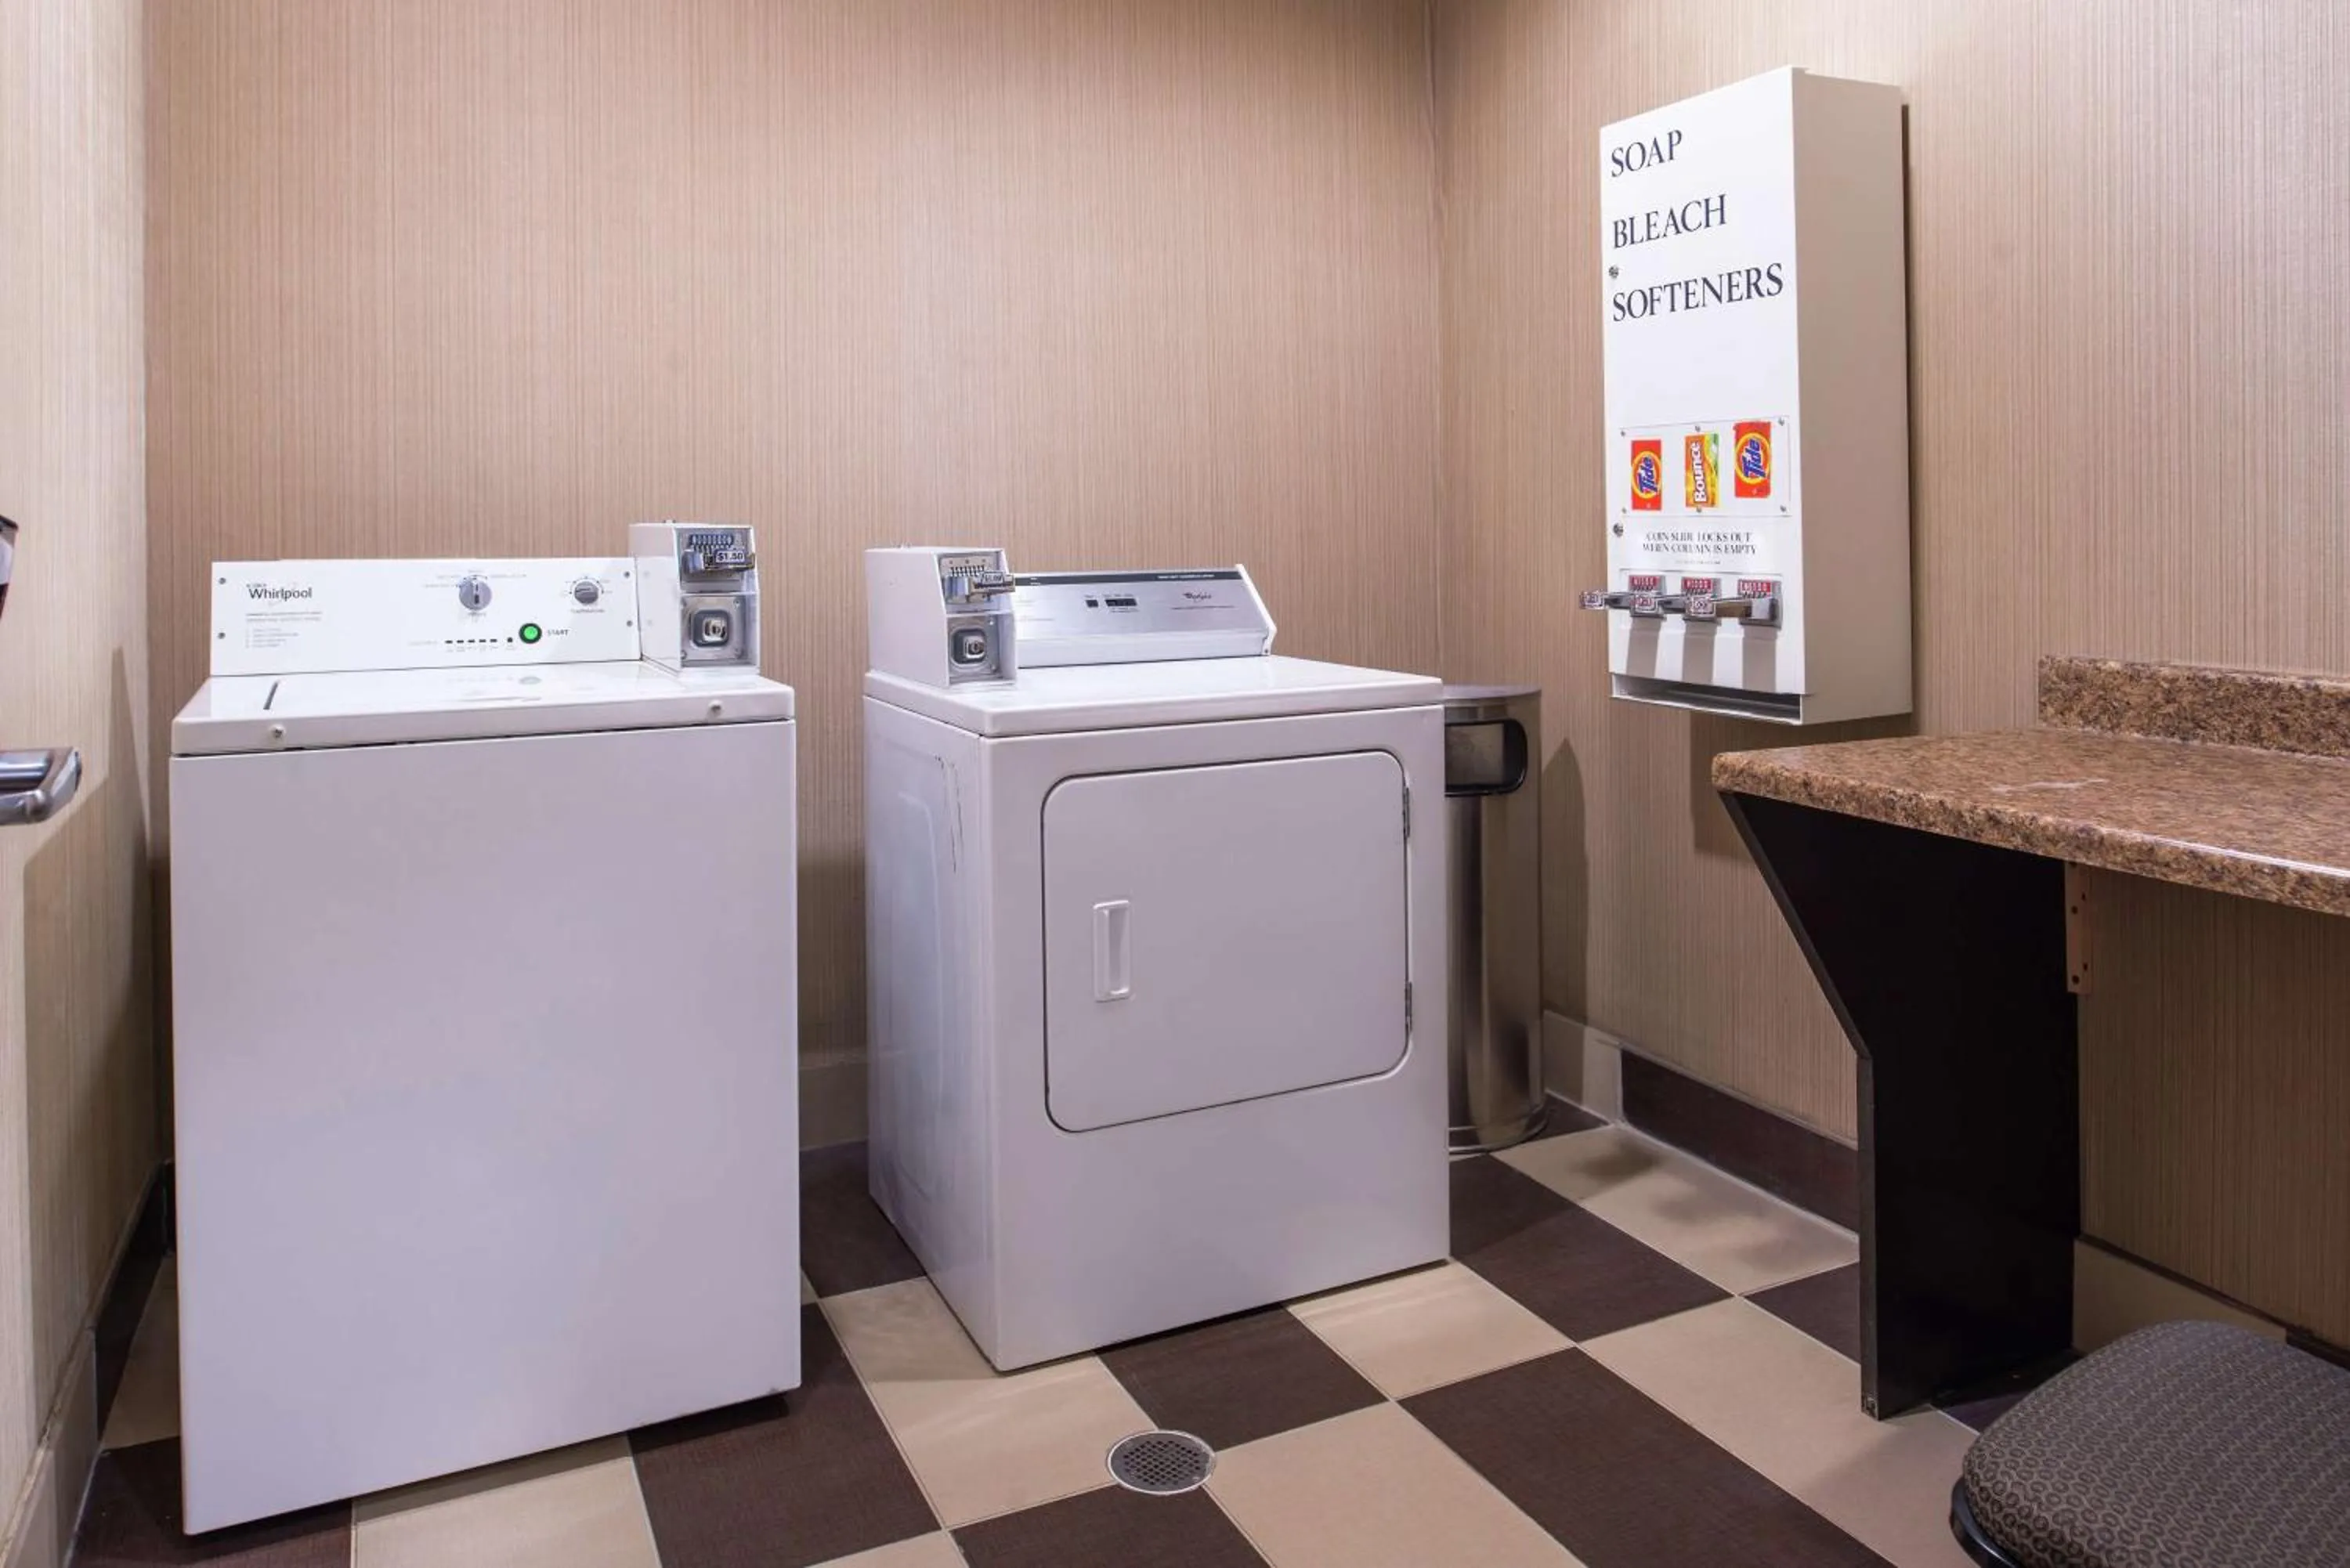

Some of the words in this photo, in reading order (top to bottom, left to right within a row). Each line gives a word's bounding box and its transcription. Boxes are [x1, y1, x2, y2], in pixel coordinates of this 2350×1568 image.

[1611, 129, 1683, 178] SOAP
[1612, 193, 1728, 249] BLEACH
[1612, 262, 1784, 322] SOFTENERS
[1637, 456, 1658, 493] Tide
[1741, 437, 1767, 479] Tide
[248, 587, 313, 602] Whirlpool
